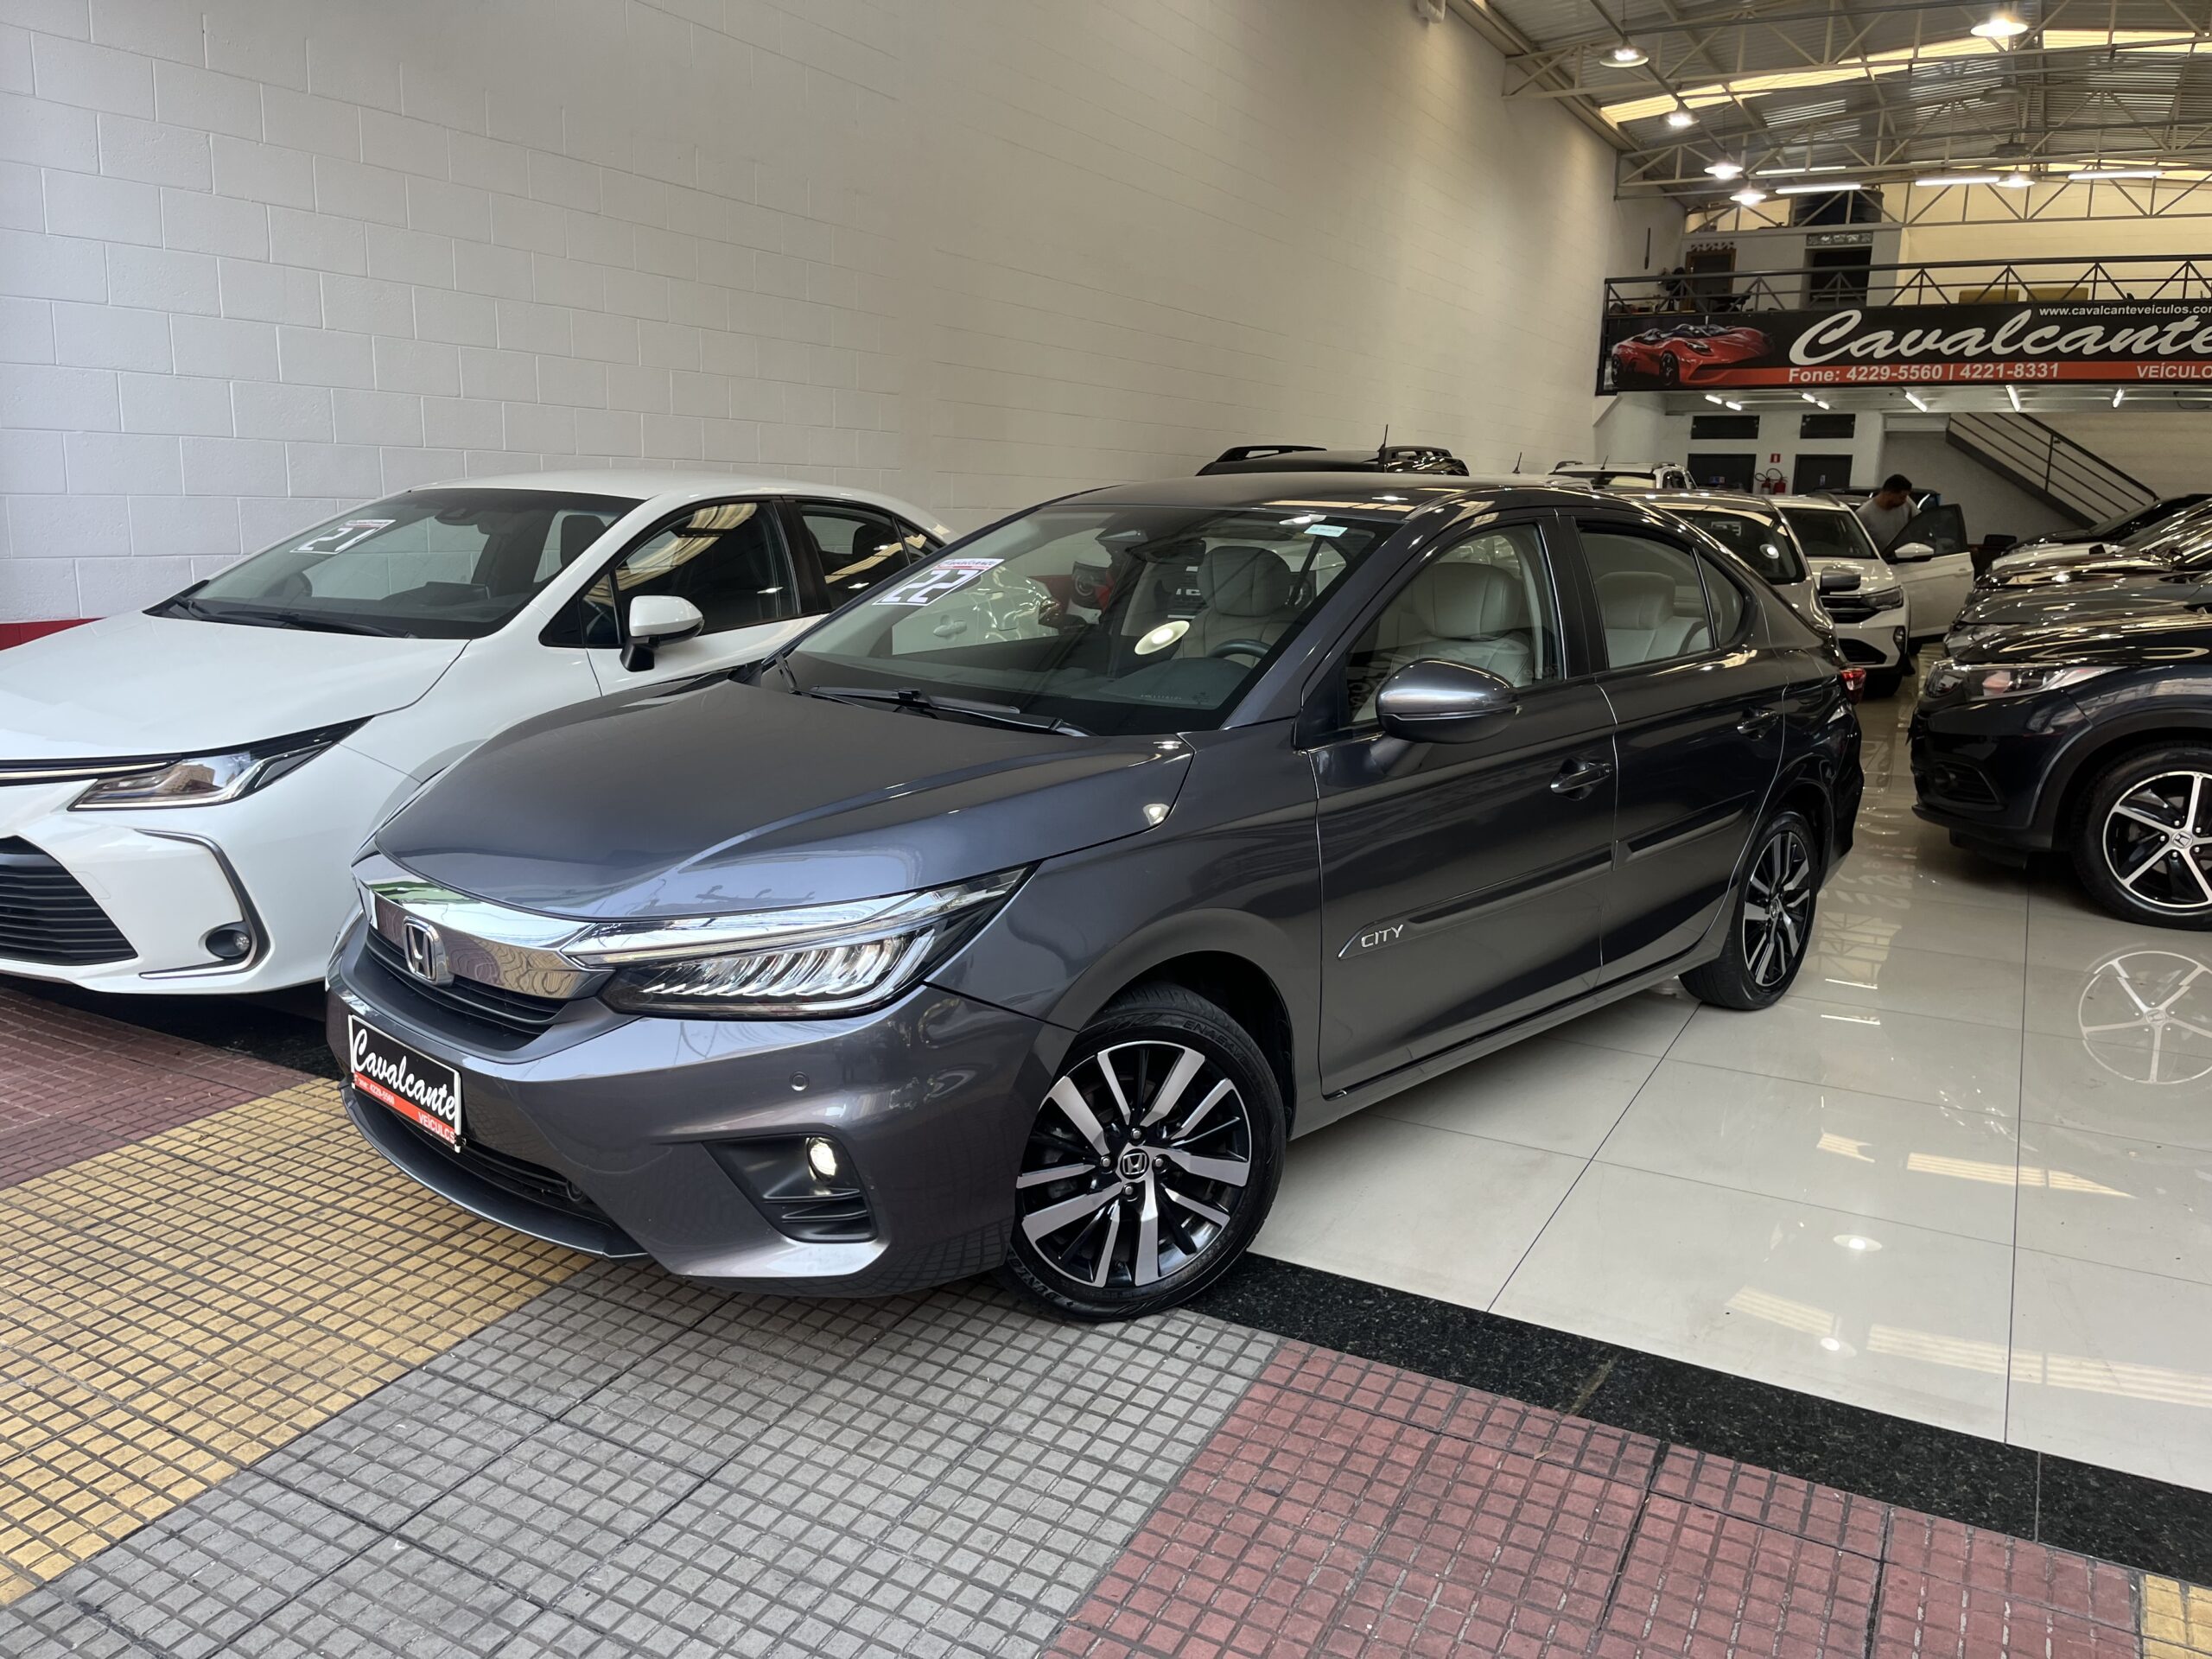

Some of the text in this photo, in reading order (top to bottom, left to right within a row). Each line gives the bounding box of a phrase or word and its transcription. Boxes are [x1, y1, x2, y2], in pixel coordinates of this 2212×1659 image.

[1789, 308, 2212, 366] Cavalcante
[1789, 367, 1840, 382] Fone:
[1846, 364, 1942, 381] 4229-5560
[1960, 362, 2059, 379] 4221-8331
[881, 569, 979, 603] 22
[1361, 924, 1403, 948] CITY
[353, 1028, 456, 1121] Cavalcante
